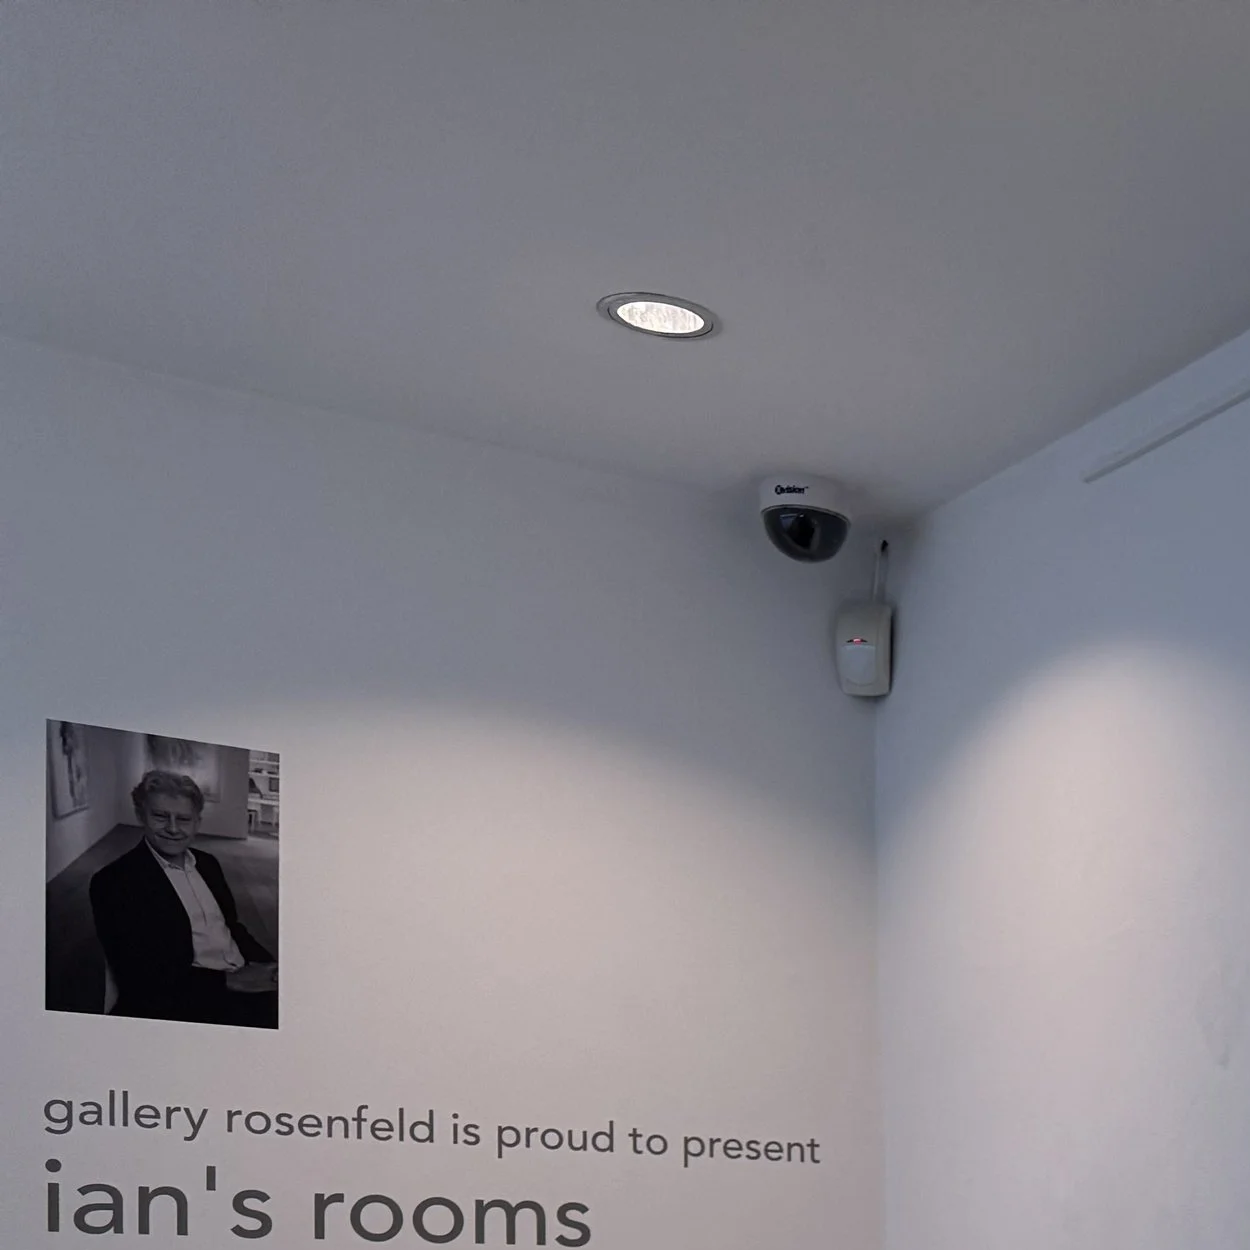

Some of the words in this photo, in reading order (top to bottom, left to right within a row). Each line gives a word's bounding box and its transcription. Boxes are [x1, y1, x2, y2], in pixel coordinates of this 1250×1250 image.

[44, 1090, 208, 1141] gallery
[227, 1105, 434, 1143] rosenfeld
[452, 1113, 480, 1145] is
[498, 1121, 613, 1158] proud
[628, 1128, 668, 1155] to
[684, 1137, 820, 1168] present
[45, 1159, 272, 1239] ian's
[314, 1193, 591, 1247] rooms
